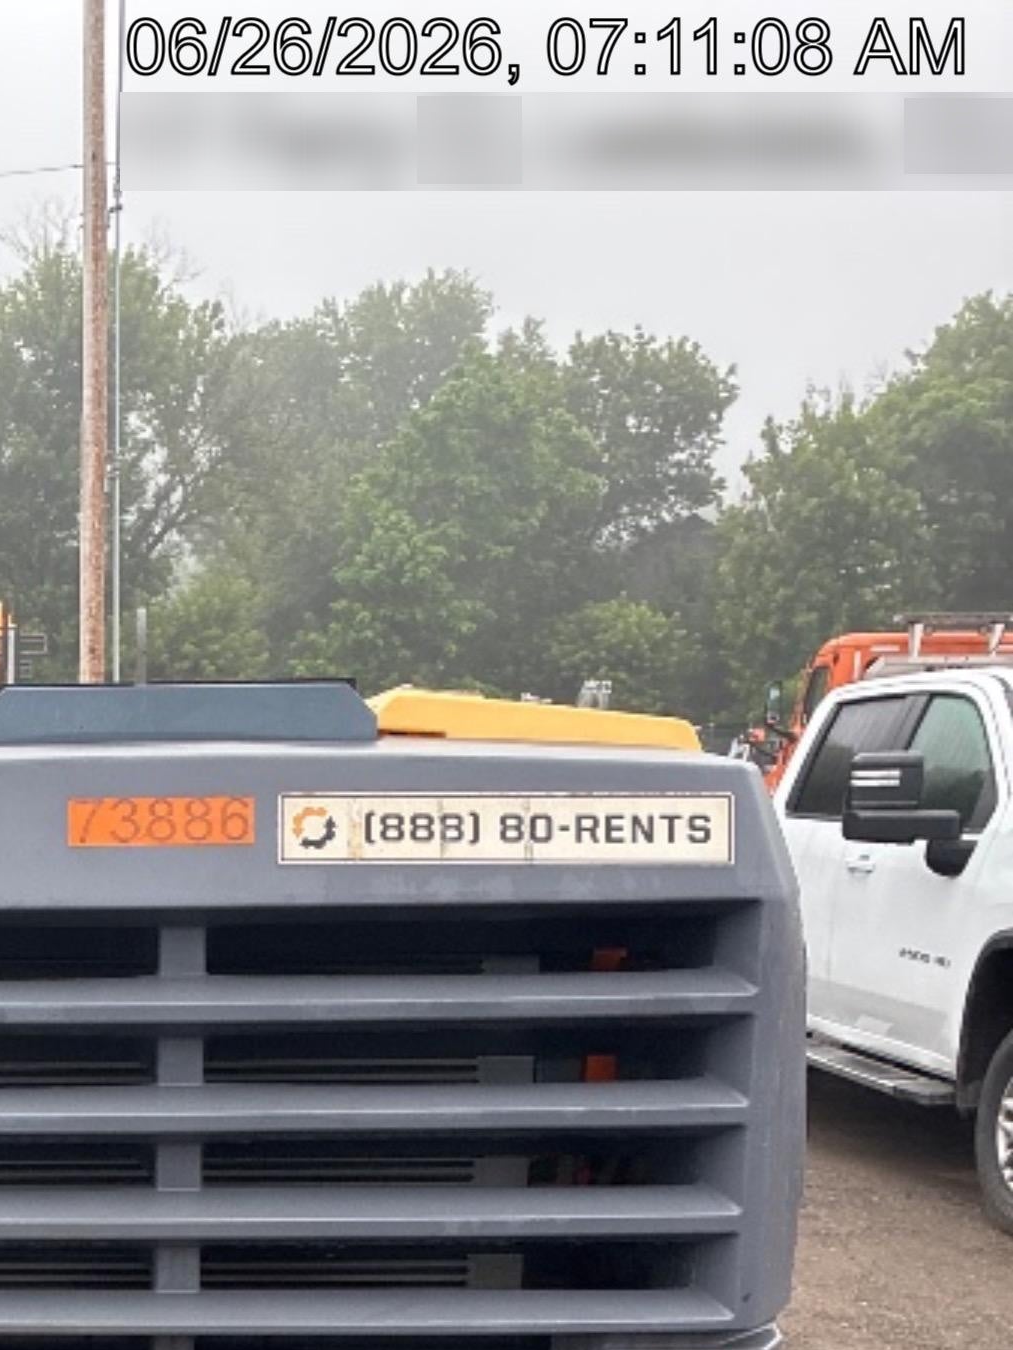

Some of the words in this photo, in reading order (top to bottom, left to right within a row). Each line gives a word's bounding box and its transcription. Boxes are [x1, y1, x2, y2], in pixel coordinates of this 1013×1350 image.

[73, 797, 251, 844] 73886
[363, 811, 481, 845] (888)
[498, 812, 713, 845] 80-RENTS
